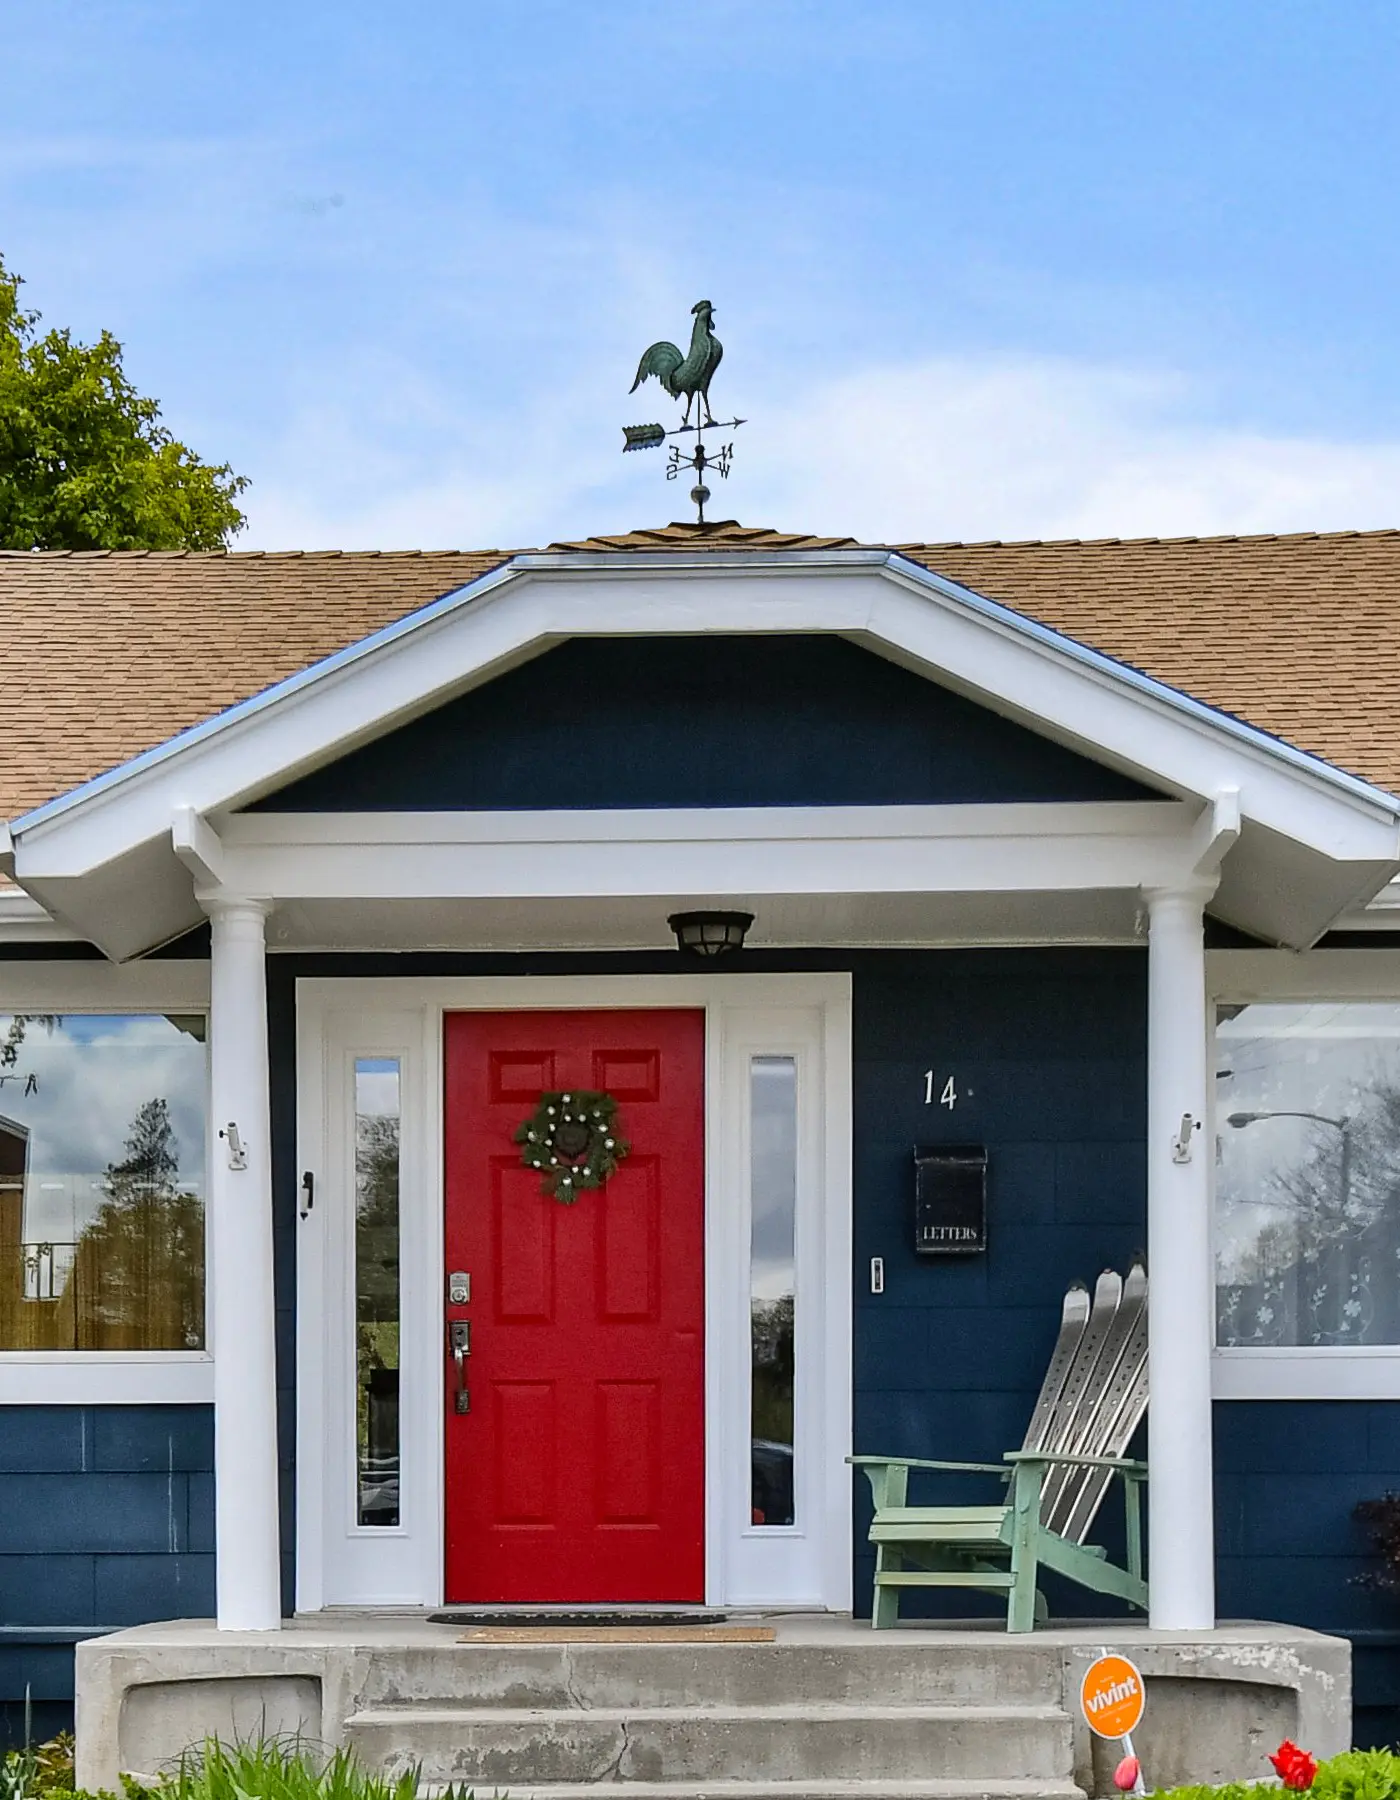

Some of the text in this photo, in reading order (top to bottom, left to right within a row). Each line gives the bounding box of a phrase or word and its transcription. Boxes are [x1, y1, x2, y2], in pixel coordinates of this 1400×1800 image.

[924, 1069, 957, 1110] 14
[923, 1226, 977, 1240] LETTERS
[1086, 1676, 1138, 1713] vivint
